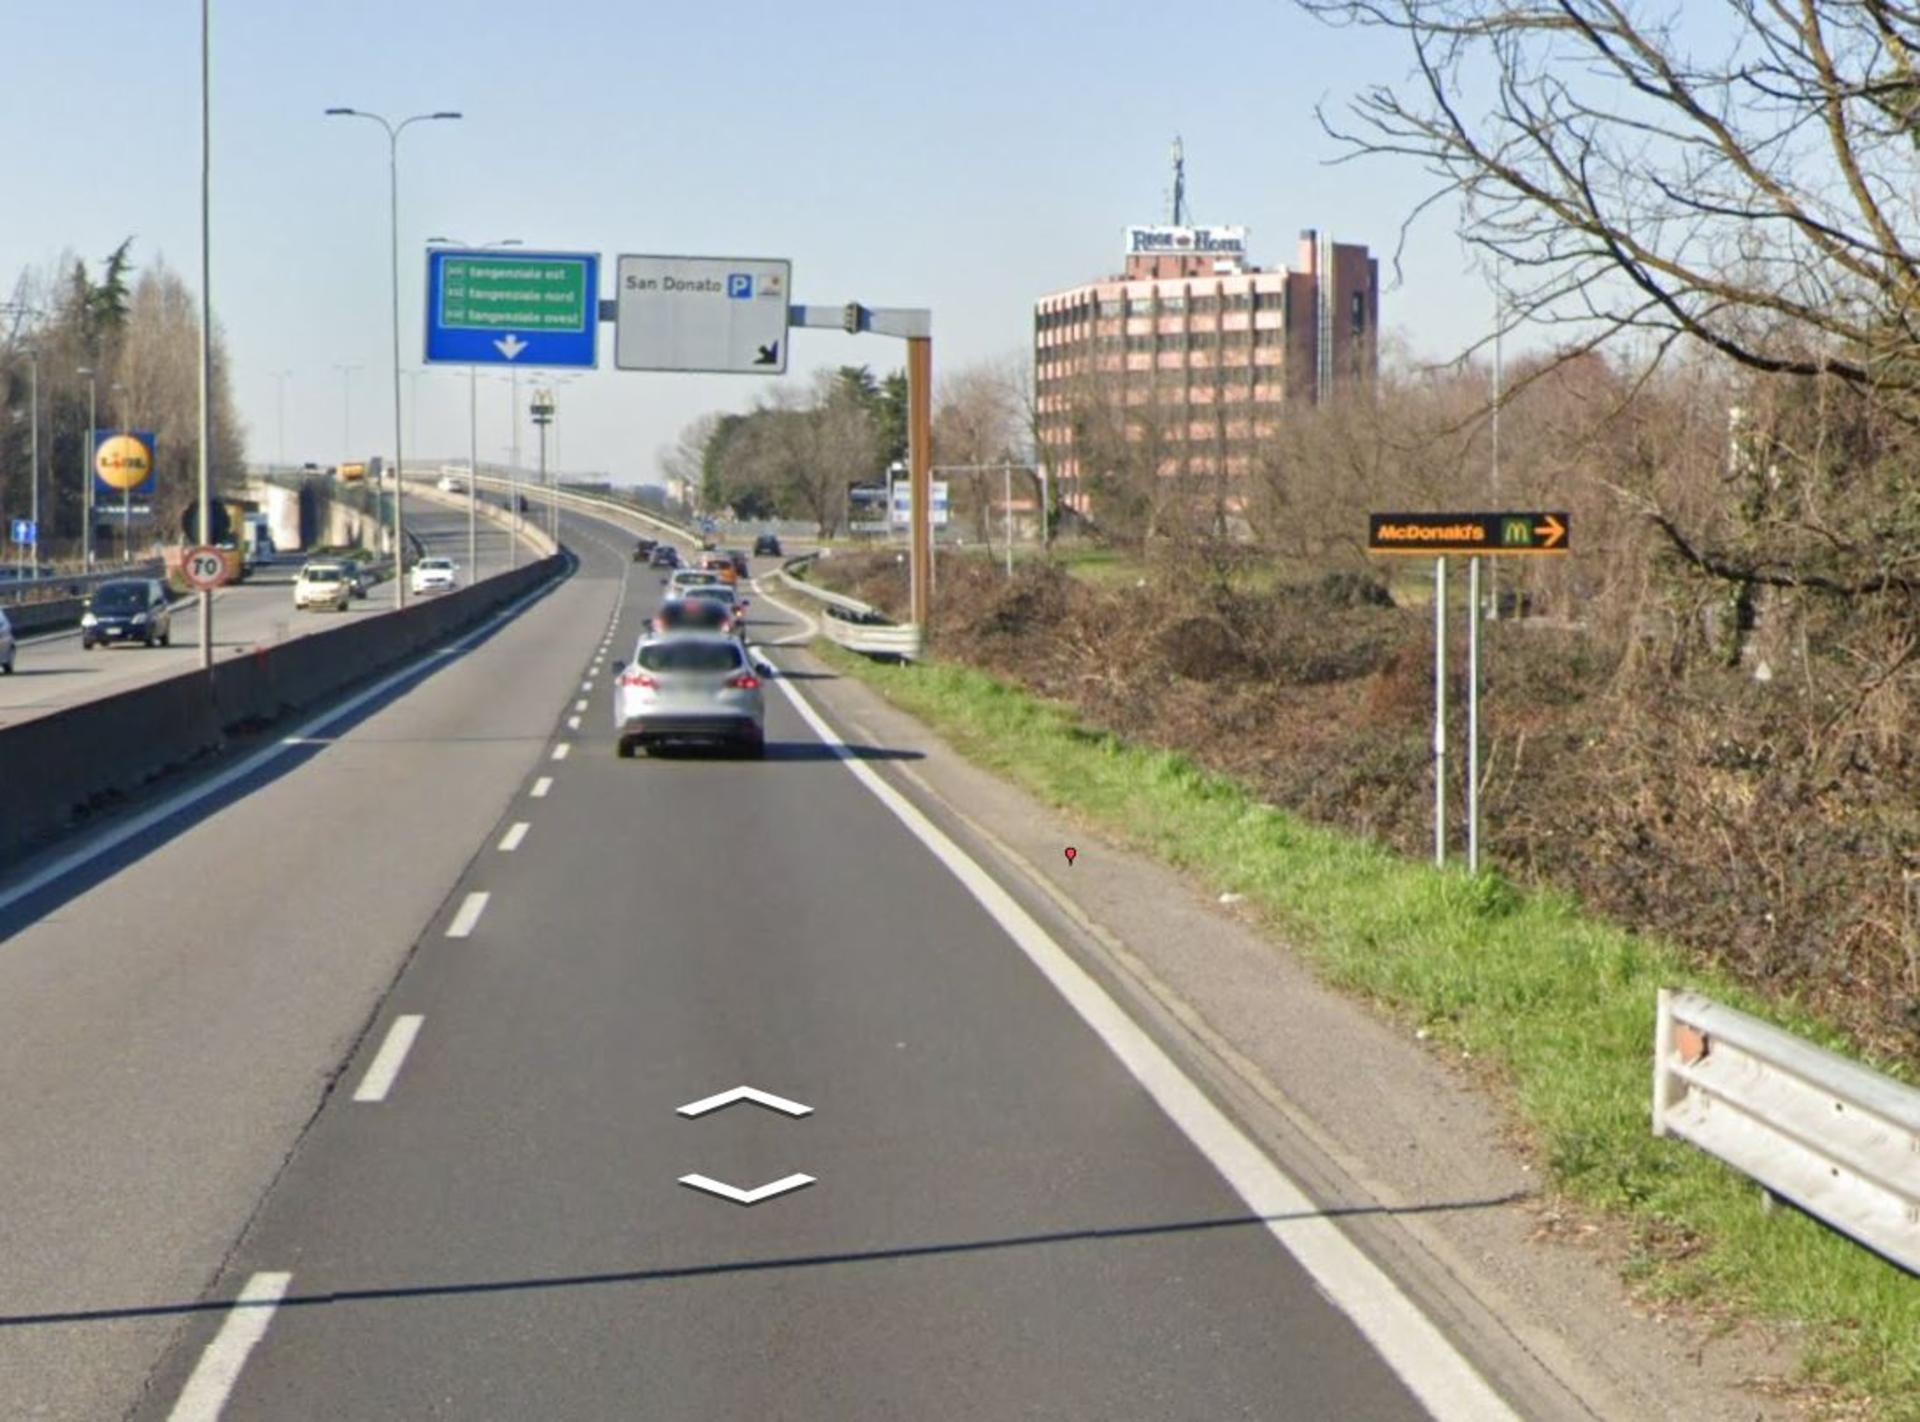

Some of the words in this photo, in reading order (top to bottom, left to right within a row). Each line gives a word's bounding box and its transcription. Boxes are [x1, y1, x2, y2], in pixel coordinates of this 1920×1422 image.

[468, 266, 542, 281] tangenziale
[626, 275, 658, 289] San
[664, 276, 722, 292] Donato
[468, 287, 541, 302] tangenziale
[1377, 522, 1485, 541] McDonald's
[194, 558, 217, 576] 70
